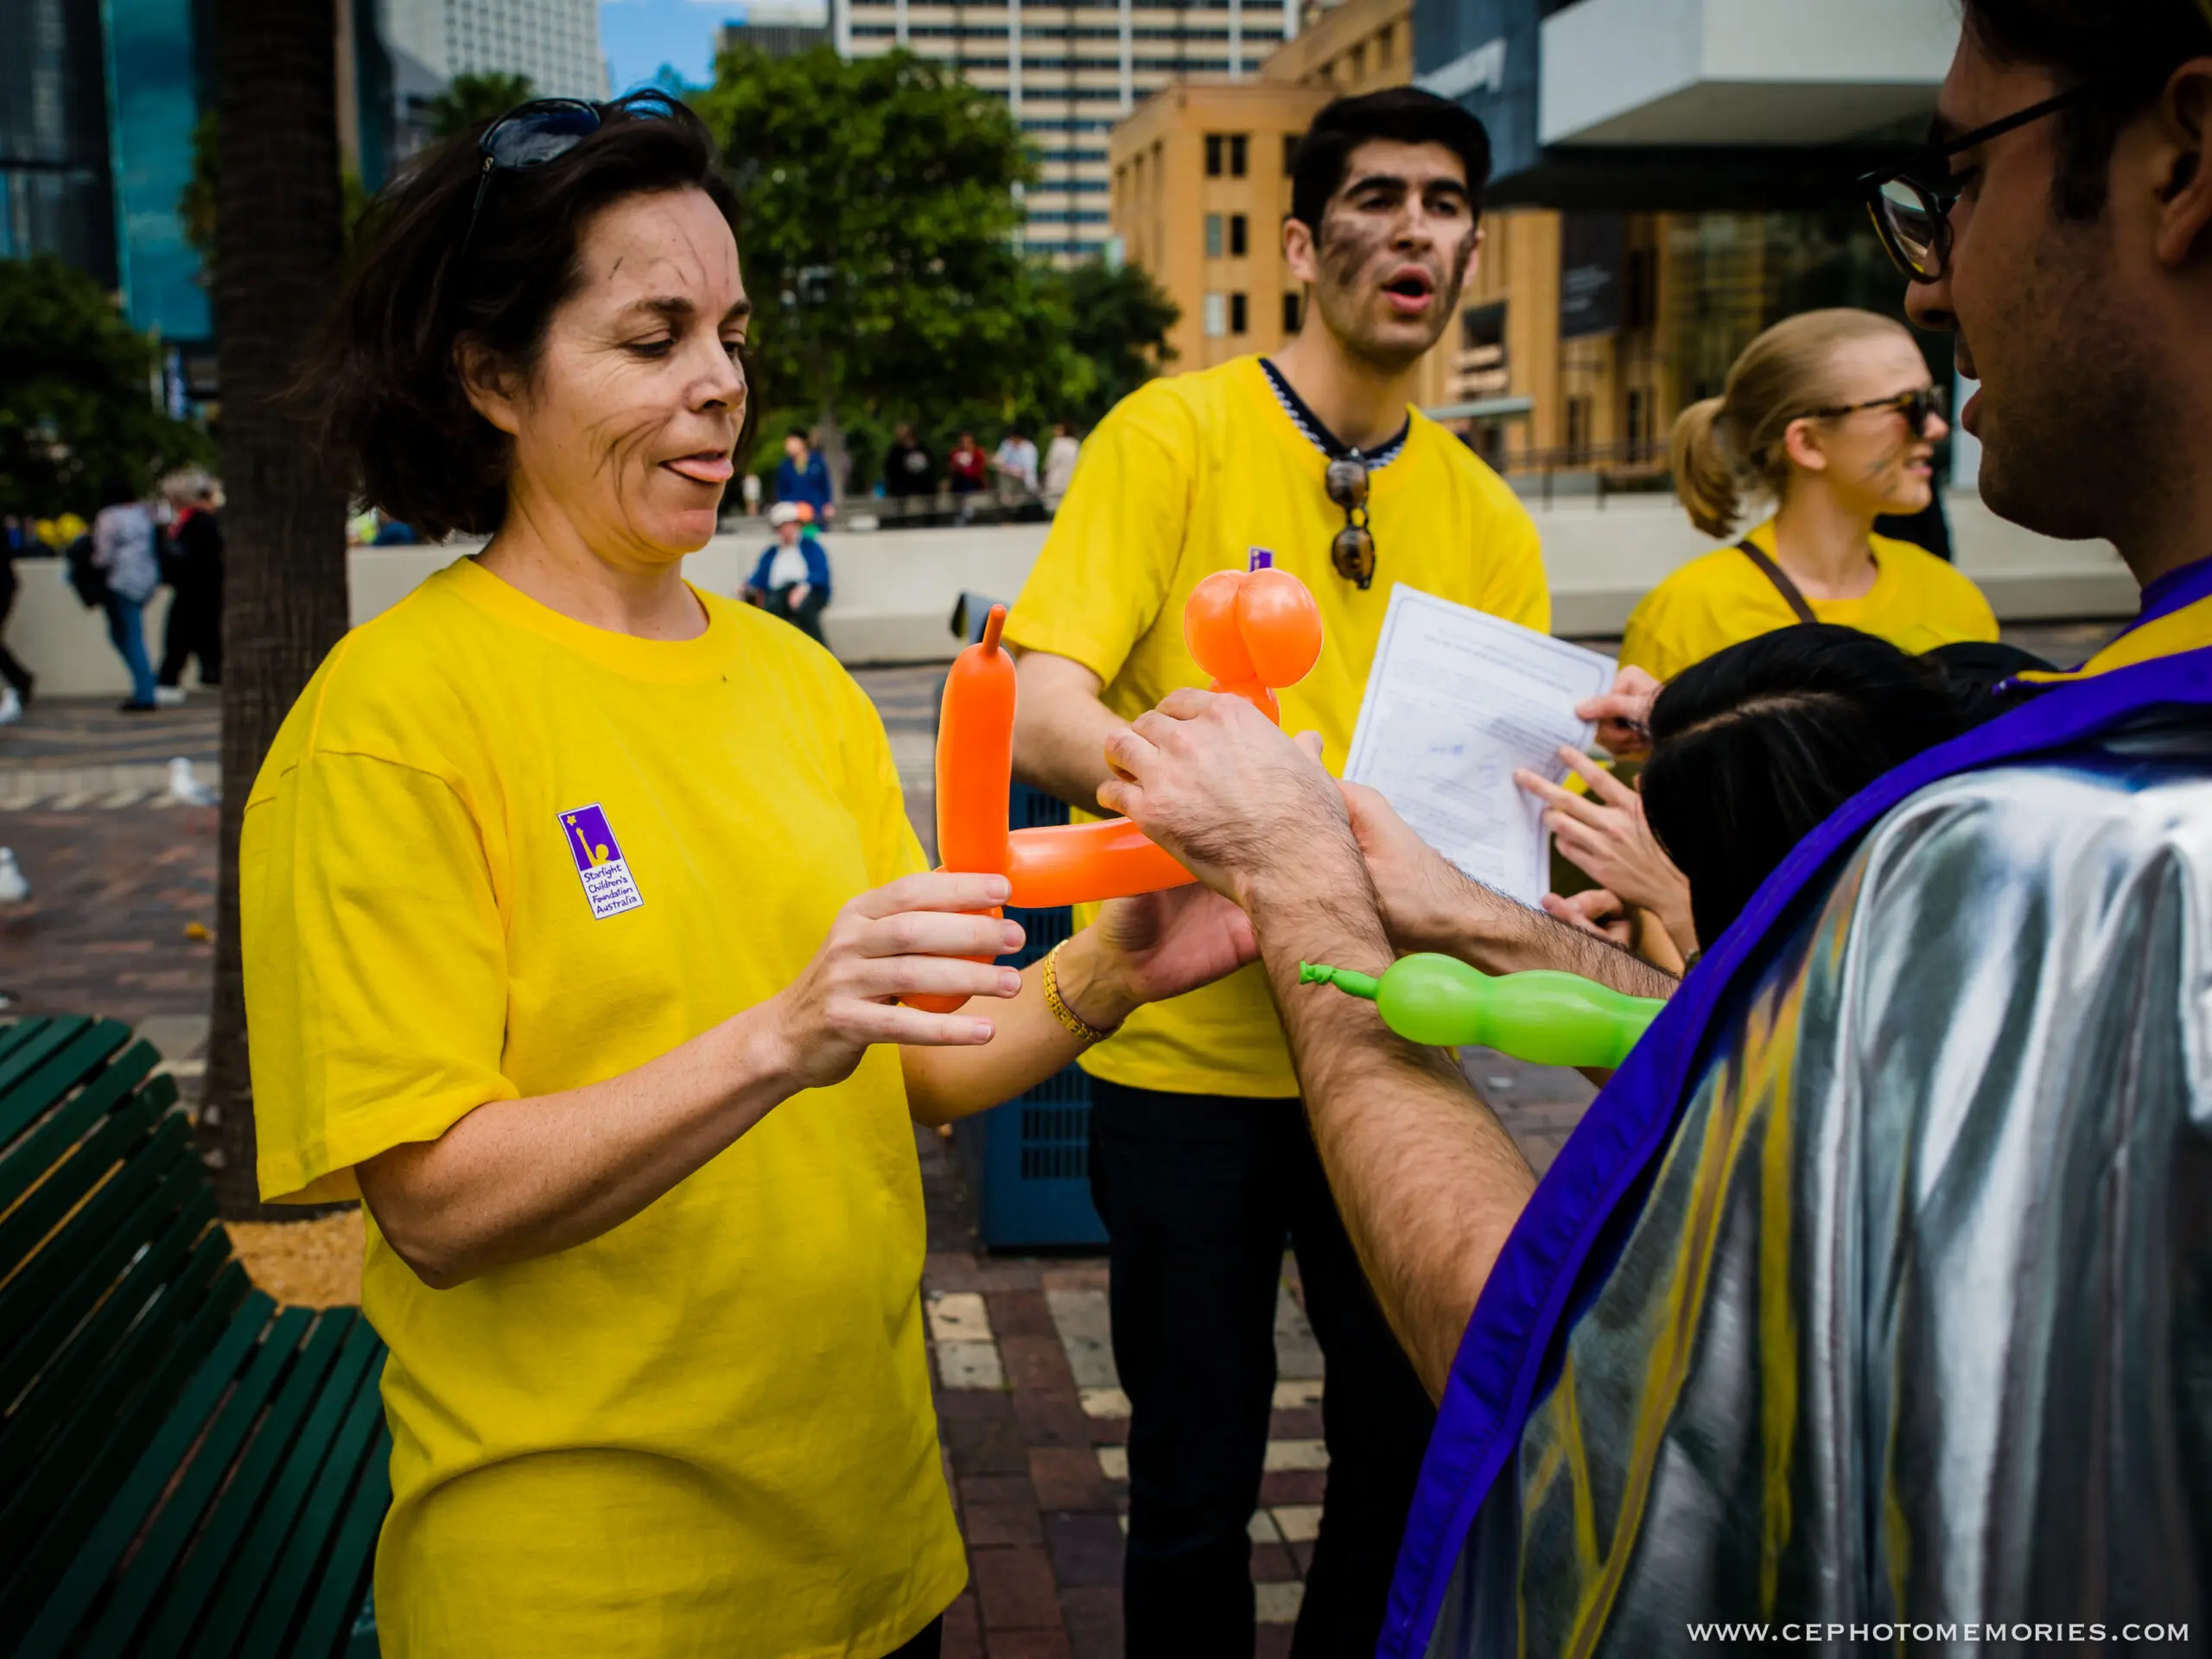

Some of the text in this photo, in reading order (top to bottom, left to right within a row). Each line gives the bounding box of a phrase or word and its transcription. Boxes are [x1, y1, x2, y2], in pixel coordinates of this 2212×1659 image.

[584, 864, 621, 882] Starlight
[588, 875, 628, 893] Children's
[592, 887, 632, 903] Foundation
[597, 895, 637, 913] Australia
